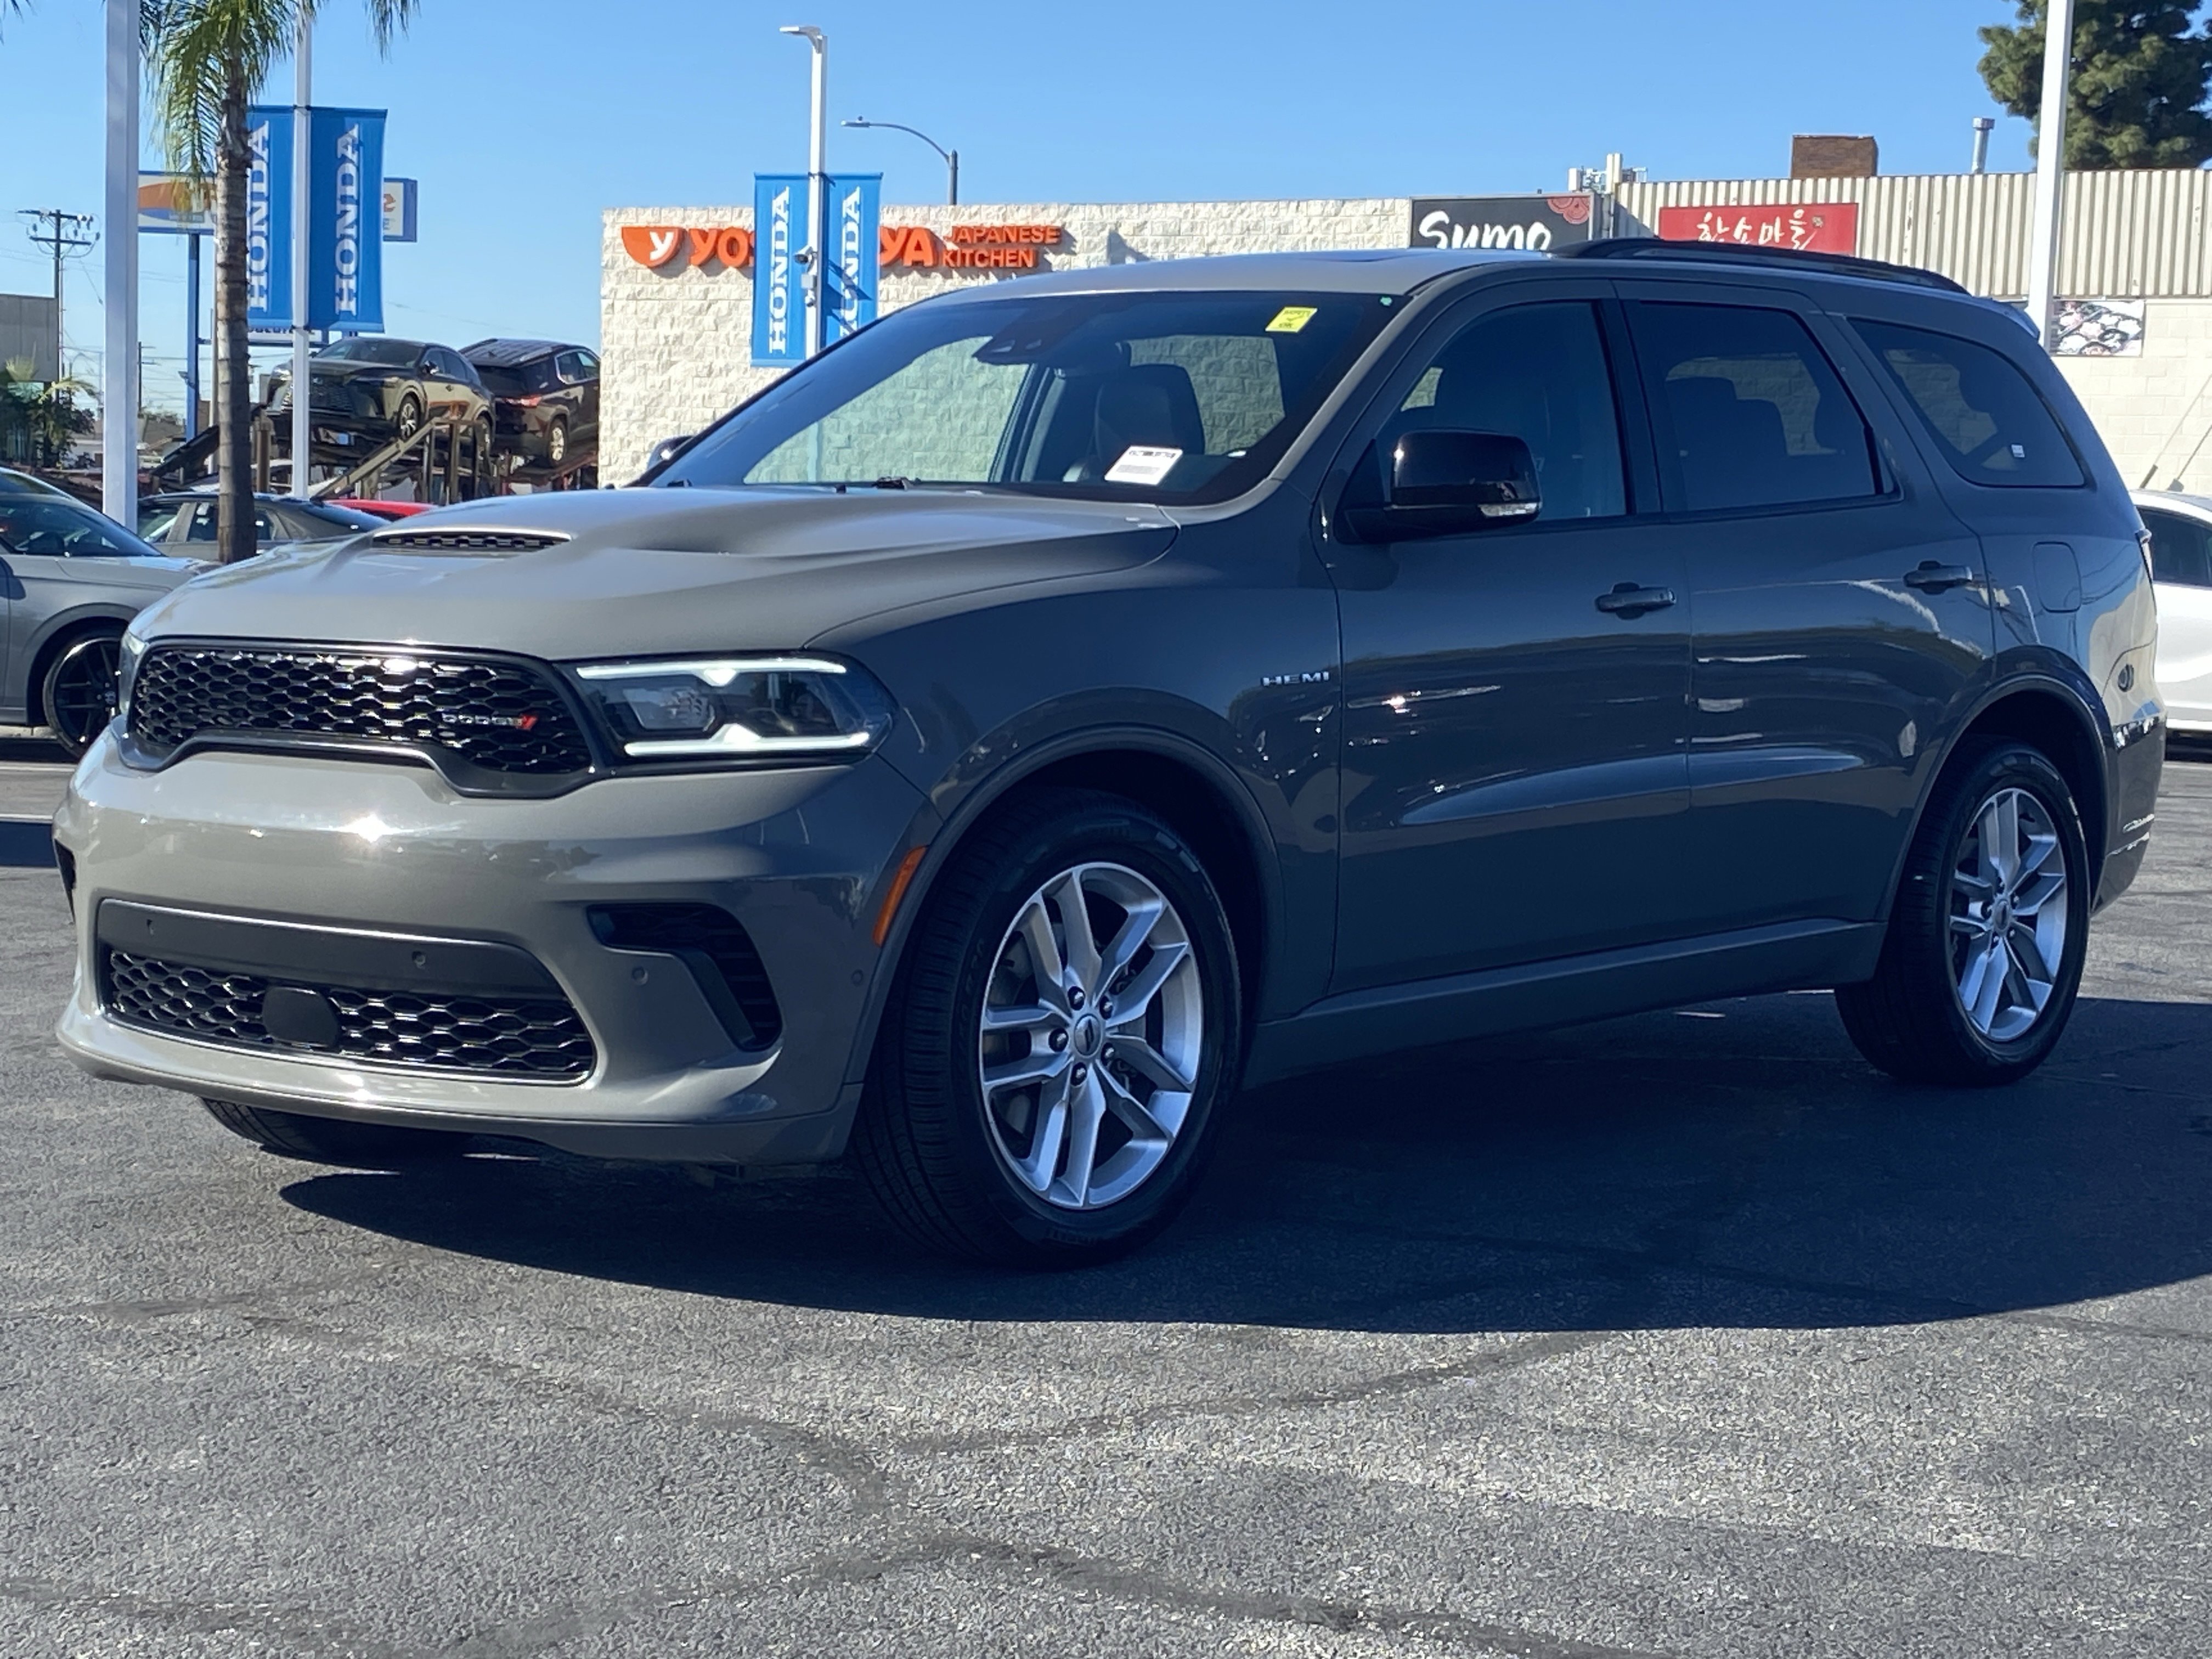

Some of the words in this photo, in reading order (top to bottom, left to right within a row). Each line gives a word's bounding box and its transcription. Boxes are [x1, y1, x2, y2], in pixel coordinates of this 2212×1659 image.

[246, 120, 269, 313] HONDA
[335, 123, 359, 315] HONDA
[942, 248, 1037, 268] KITCHEN
[943, 225, 1062, 244] JAPANESE
[769, 185, 789, 354] HONDA
[1262, 671, 1330, 686] HEMI
